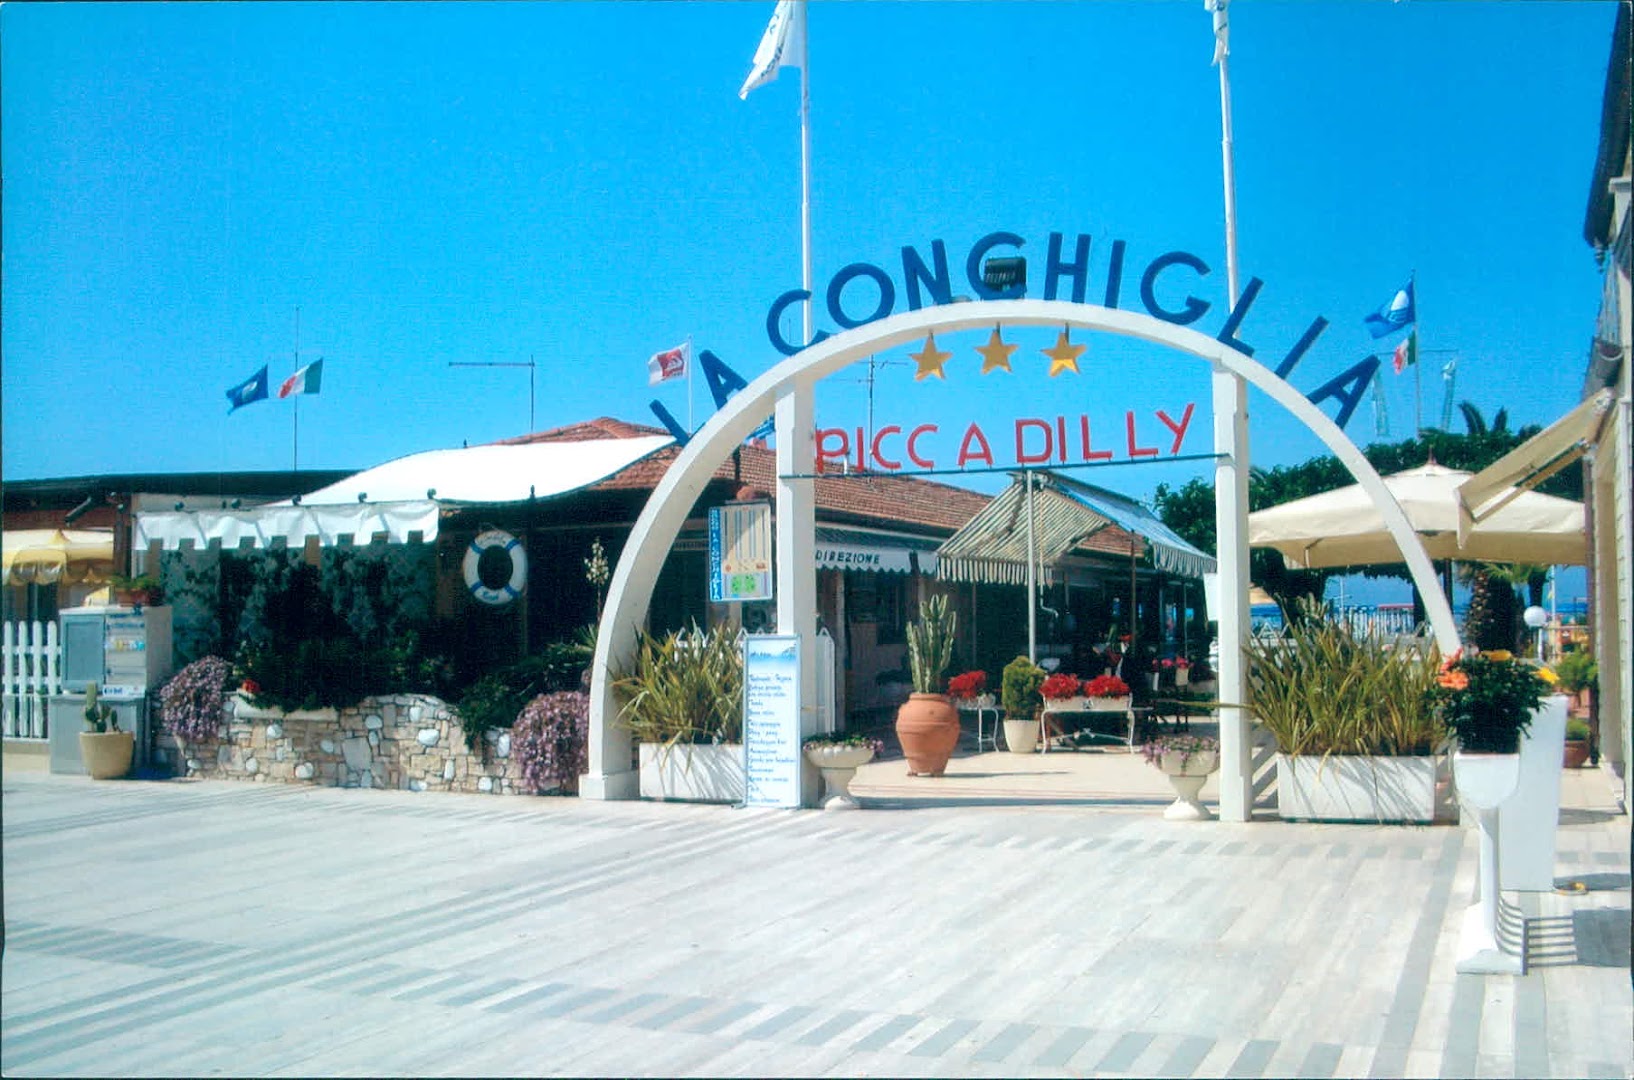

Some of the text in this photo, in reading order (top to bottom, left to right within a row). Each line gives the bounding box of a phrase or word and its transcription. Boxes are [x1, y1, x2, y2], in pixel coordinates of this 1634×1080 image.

[766, 231, 1382, 430] CONCHIGLIA
[815, 403, 1195, 473] PICCADILLY
[815, 550, 881, 564] DIREZIONE
